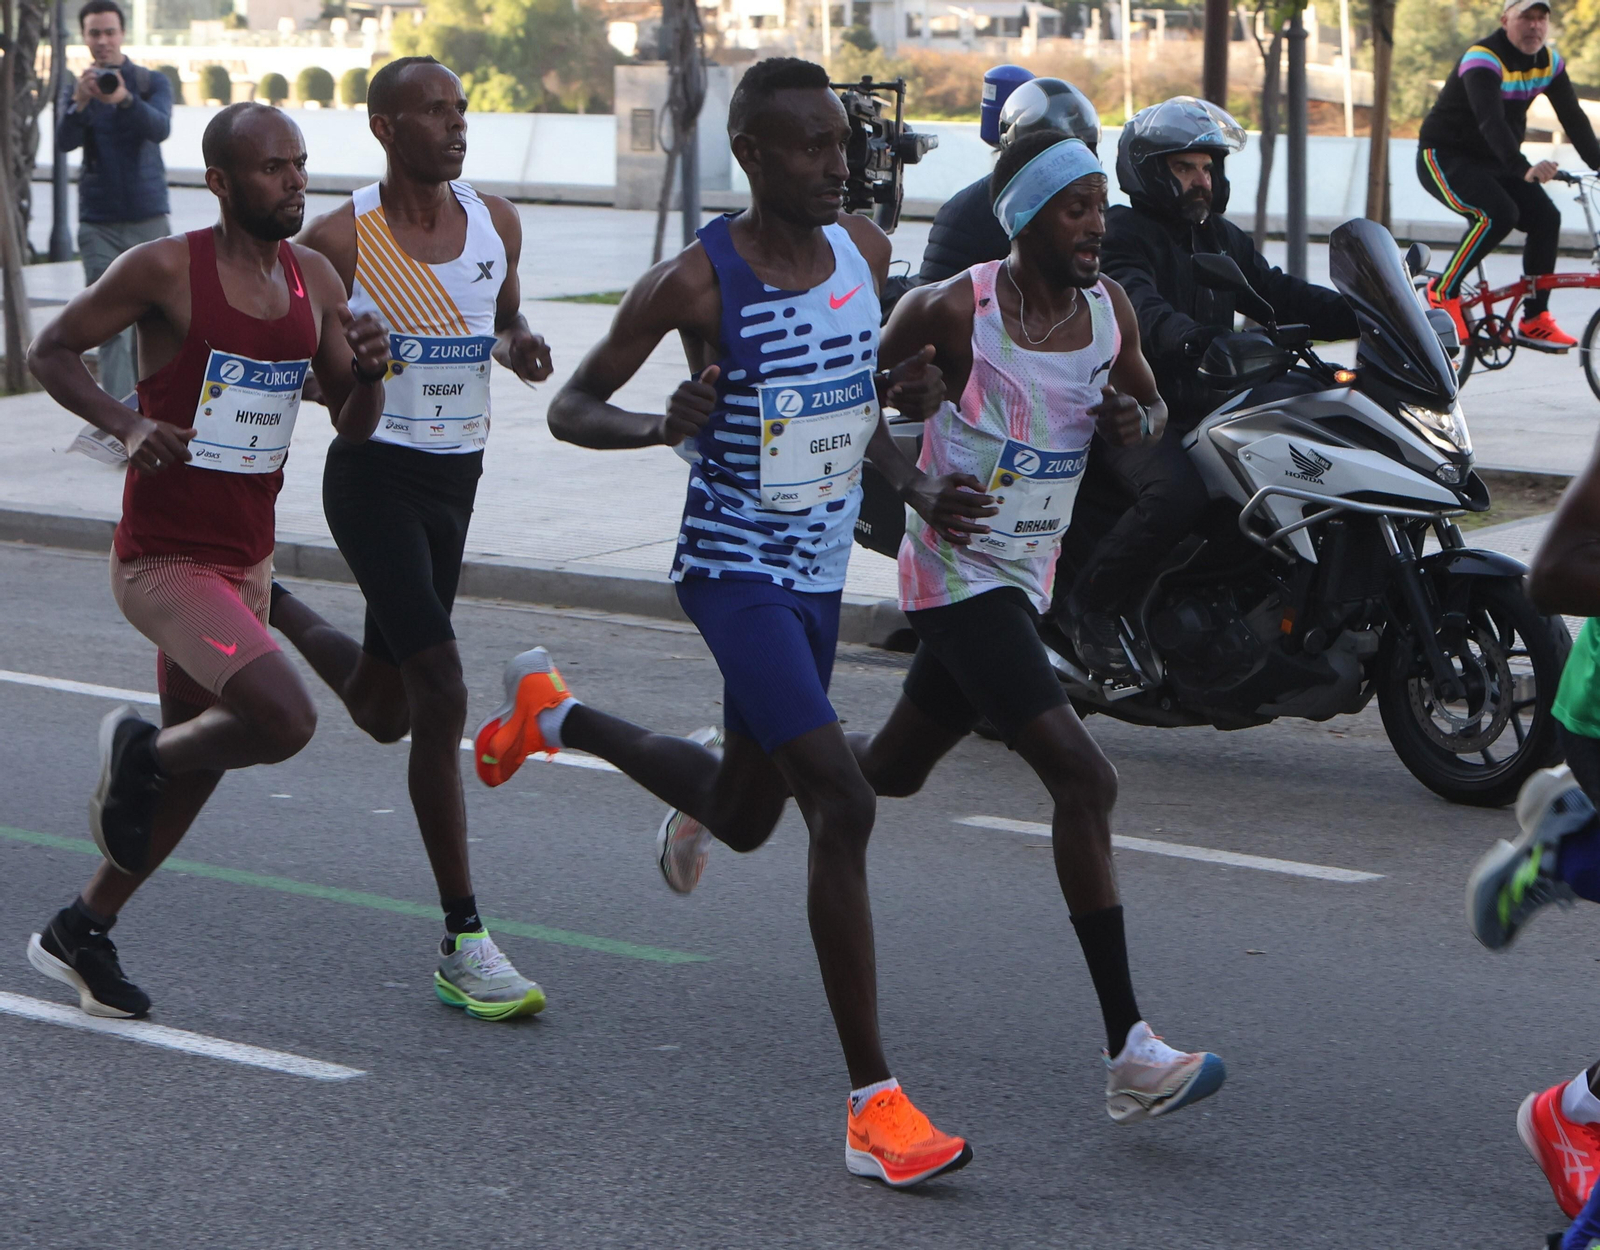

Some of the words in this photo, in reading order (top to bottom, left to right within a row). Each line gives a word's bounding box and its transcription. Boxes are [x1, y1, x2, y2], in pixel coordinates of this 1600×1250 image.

[429, 343, 483, 359] ZURICH
[250, 370, 299, 386] ZURICH
[422, 383, 465, 396] TSEGAY
[811, 382, 864, 409] ZURICH
[235, 409, 282, 426] HIYRDEN
[435, 405, 443, 417] 7
[249, 435, 258, 448] 2
[809, 433, 852, 454] GELETA
[1284, 469, 1325, 485] HONDA
[1043, 495, 1052, 510] 1
[1014, 517, 1061, 533] BIRHANU
